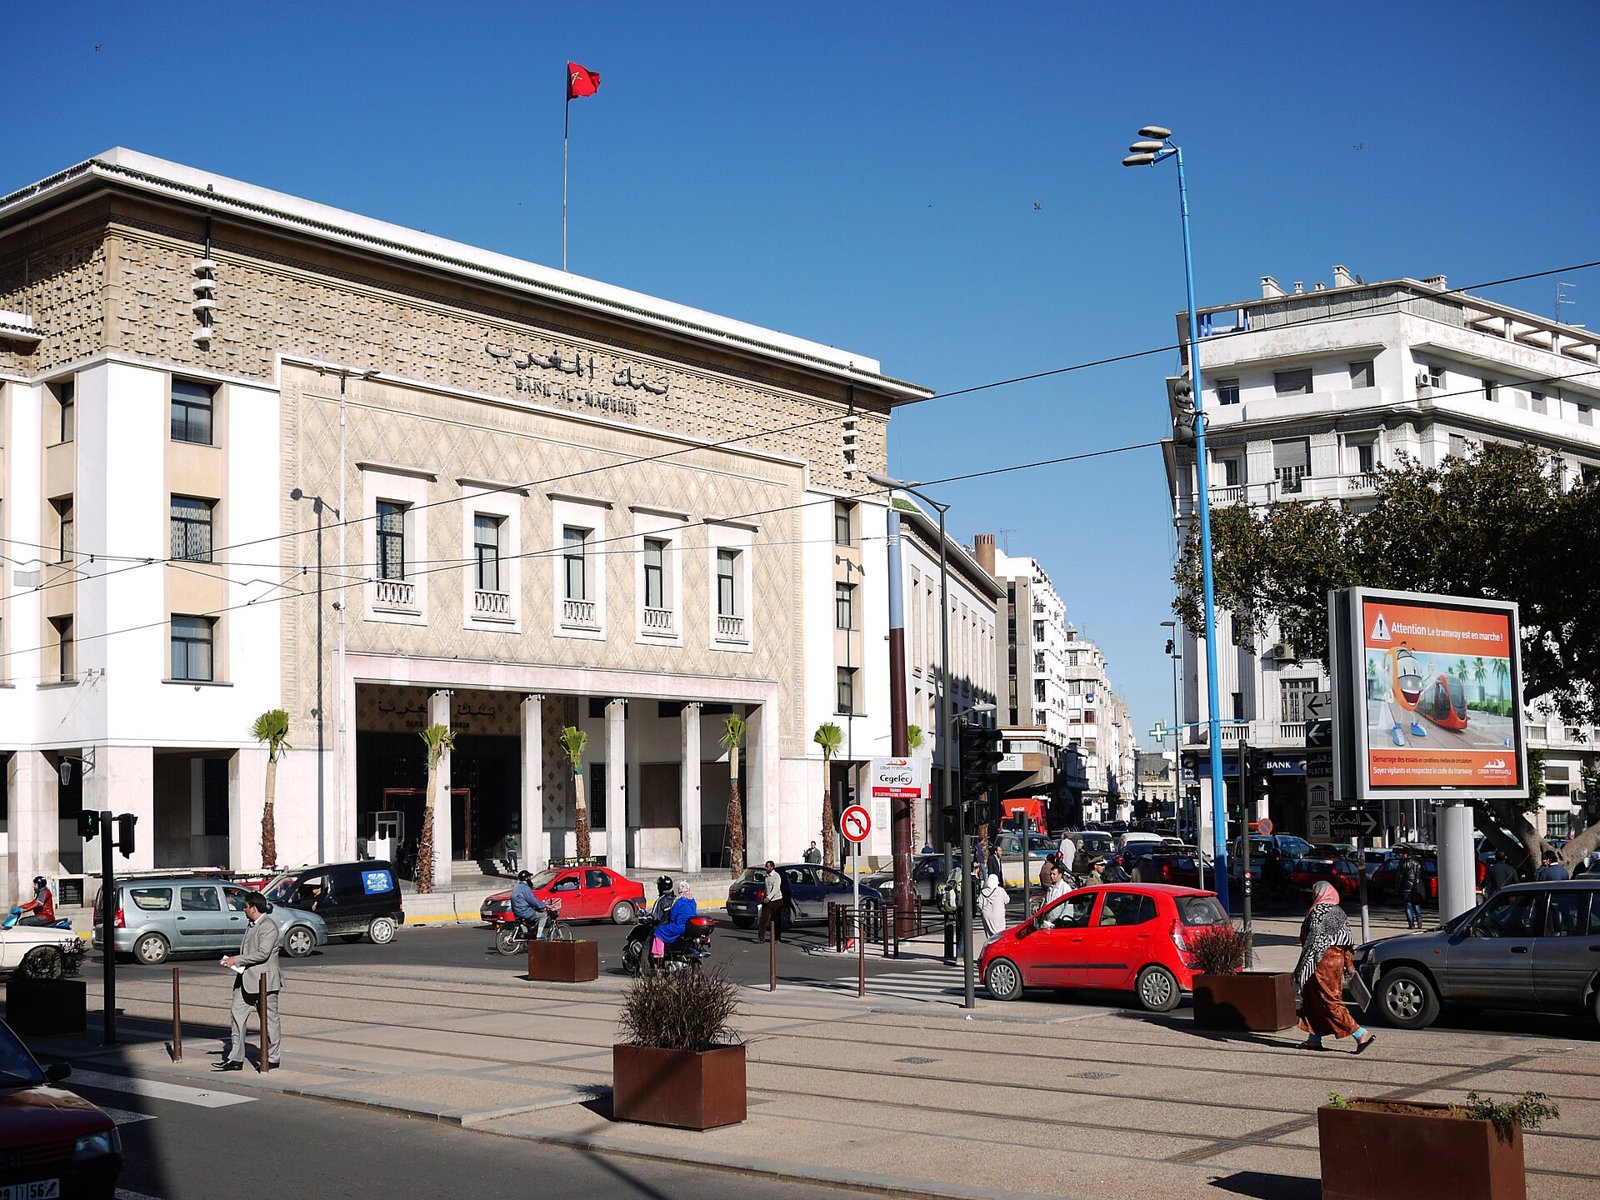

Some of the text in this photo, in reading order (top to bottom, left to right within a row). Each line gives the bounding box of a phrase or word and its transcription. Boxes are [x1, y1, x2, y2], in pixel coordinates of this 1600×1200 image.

[515, 376, 551, 397] BANK
[1391, 622, 1427, 636] Attention
[1427, 627, 1436, 636] Le
[1436, 628, 1461, 640] tramway
[1461, 630, 1471, 639] est
[1479, 632, 1500, 642] marche
[1266, 761, 1291, 769] BANK
[1372, 755, 1397, 765] Démarrage
[1397, 756, 1405, 764] des
[1373, 766, 1387, 774] Soyez
[1387, 766, 1405, 775] vigilants
[1453, 767, 1473, 776] tramway
[880, 774, 911, 784] Cegelec
